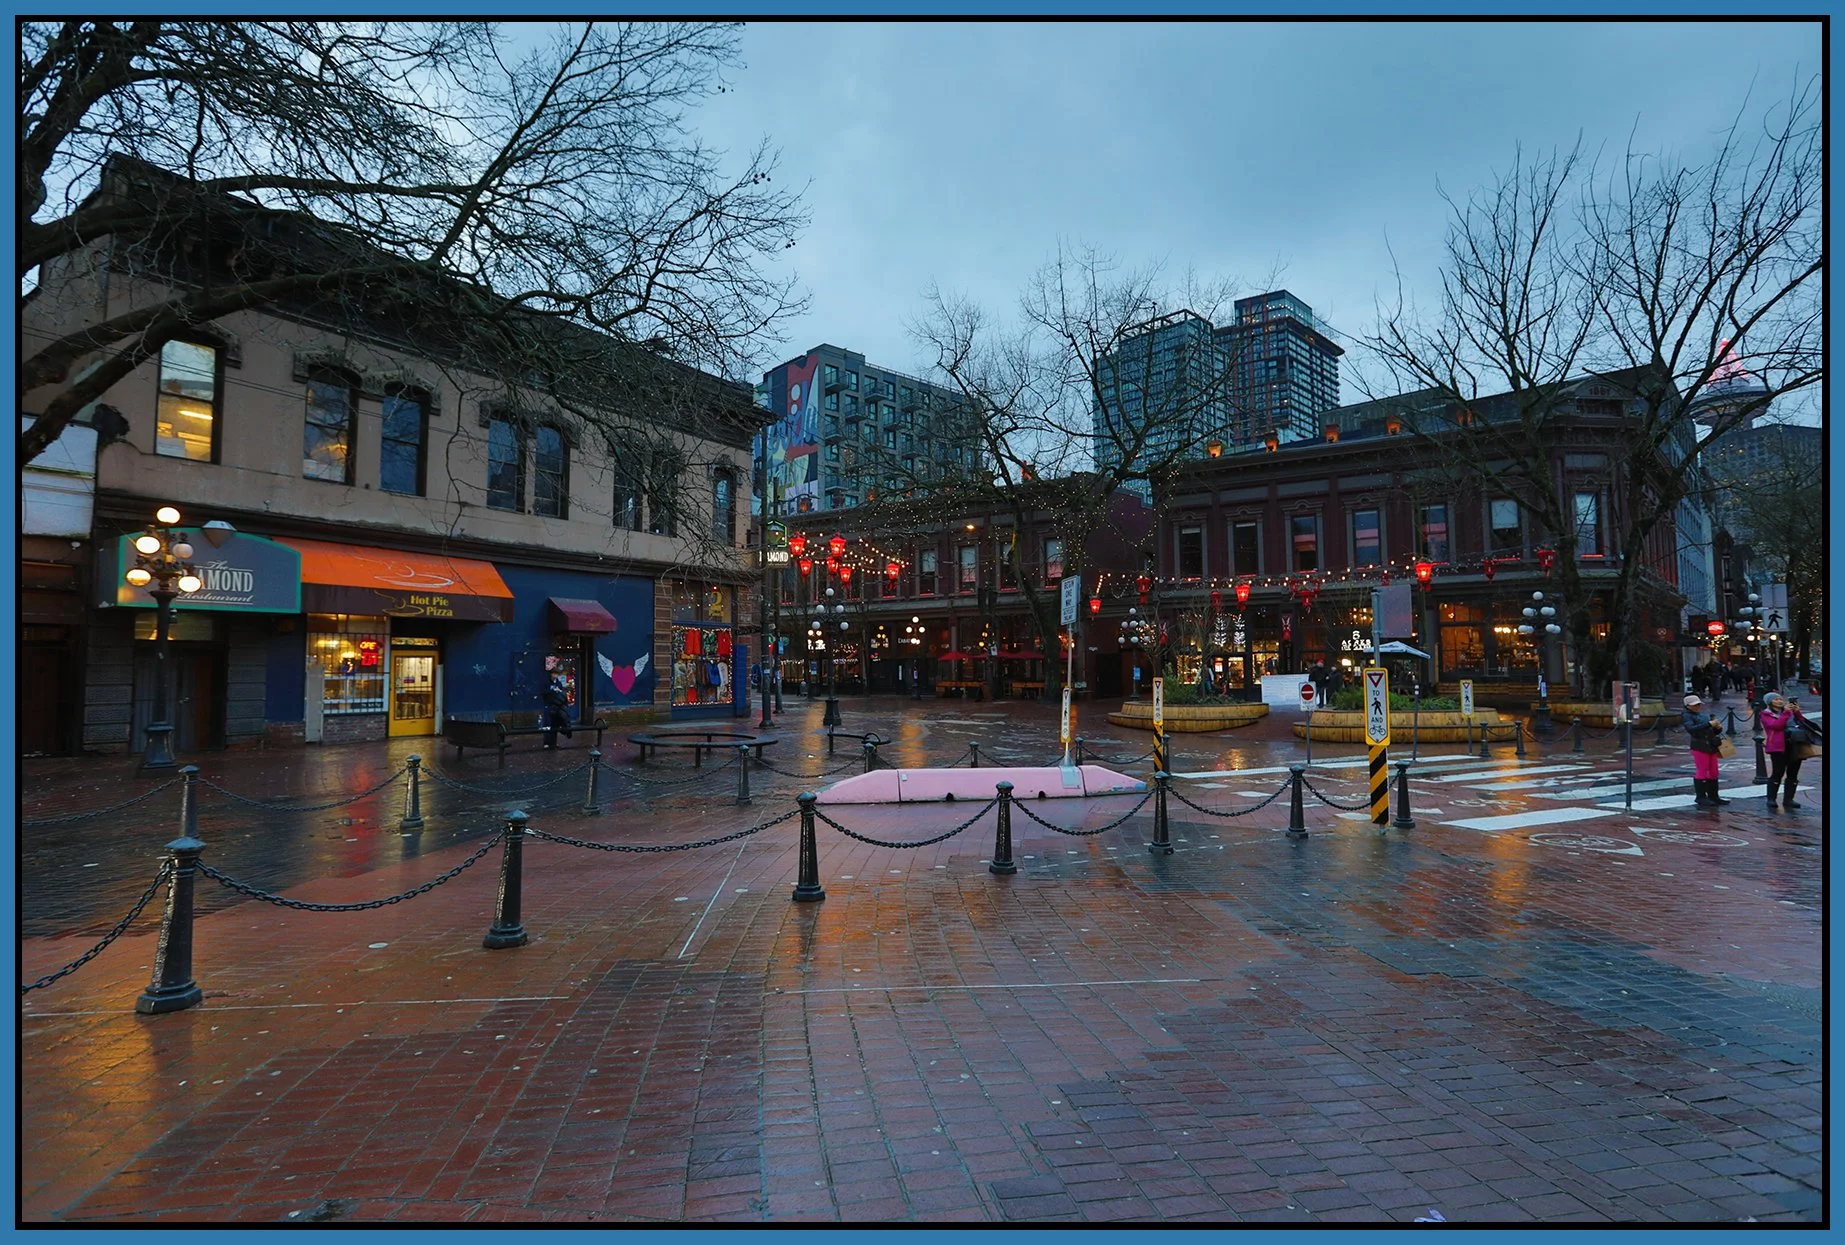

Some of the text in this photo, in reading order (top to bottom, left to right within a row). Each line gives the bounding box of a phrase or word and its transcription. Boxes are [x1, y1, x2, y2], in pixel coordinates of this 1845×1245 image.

[207, 560, 229, 570] The
[182, 569, 254, 592] AMOND
[177, 592, 254, 602] Restaurant
[411, 595, 449, 606] Hot Pie
[426, 606, 453, 616] Pizza
